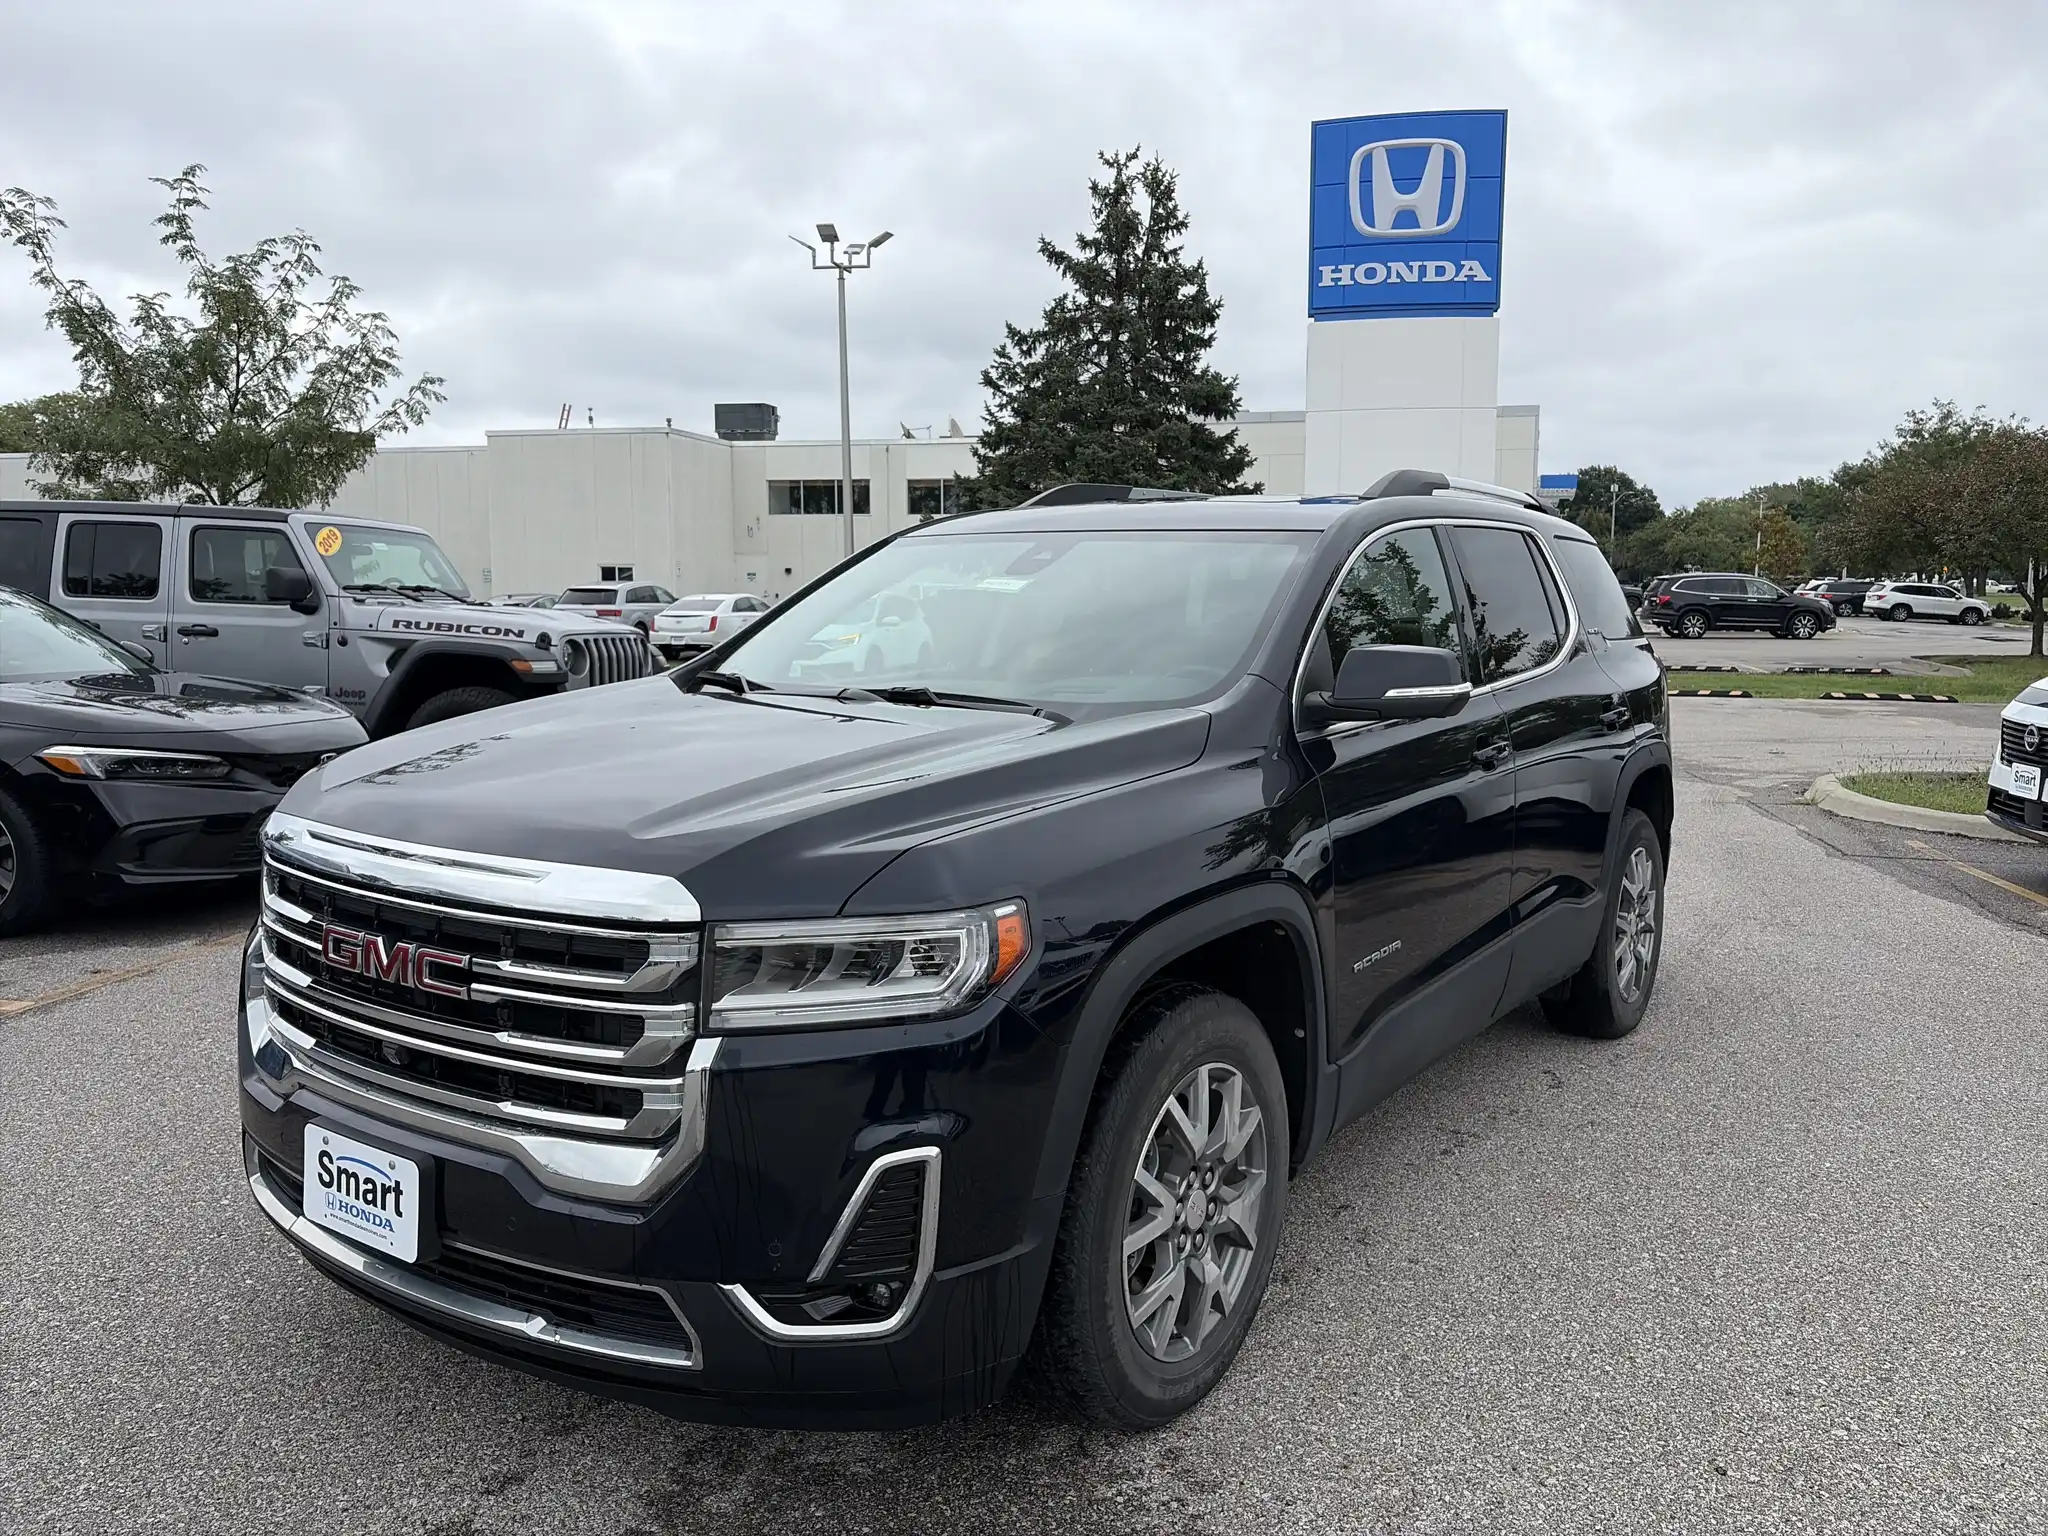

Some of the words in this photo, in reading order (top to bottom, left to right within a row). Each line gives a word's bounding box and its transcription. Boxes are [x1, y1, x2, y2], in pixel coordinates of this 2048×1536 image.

[1318, 260, 1492, 287] HONDA
[318, 529, 339, 553] 2019
[392, 619, 525, 639] RUBICON
[334, 686, 366, 701] Jeep
[2013, 770, 2036, 787] Smart
[322, 924, 471, 1001] GMC
[1353, 939, 1402, 974] ACADIA
[317, 1149, 404, 1218] Smart
[338, 1199, 396, 1233] HONDA
